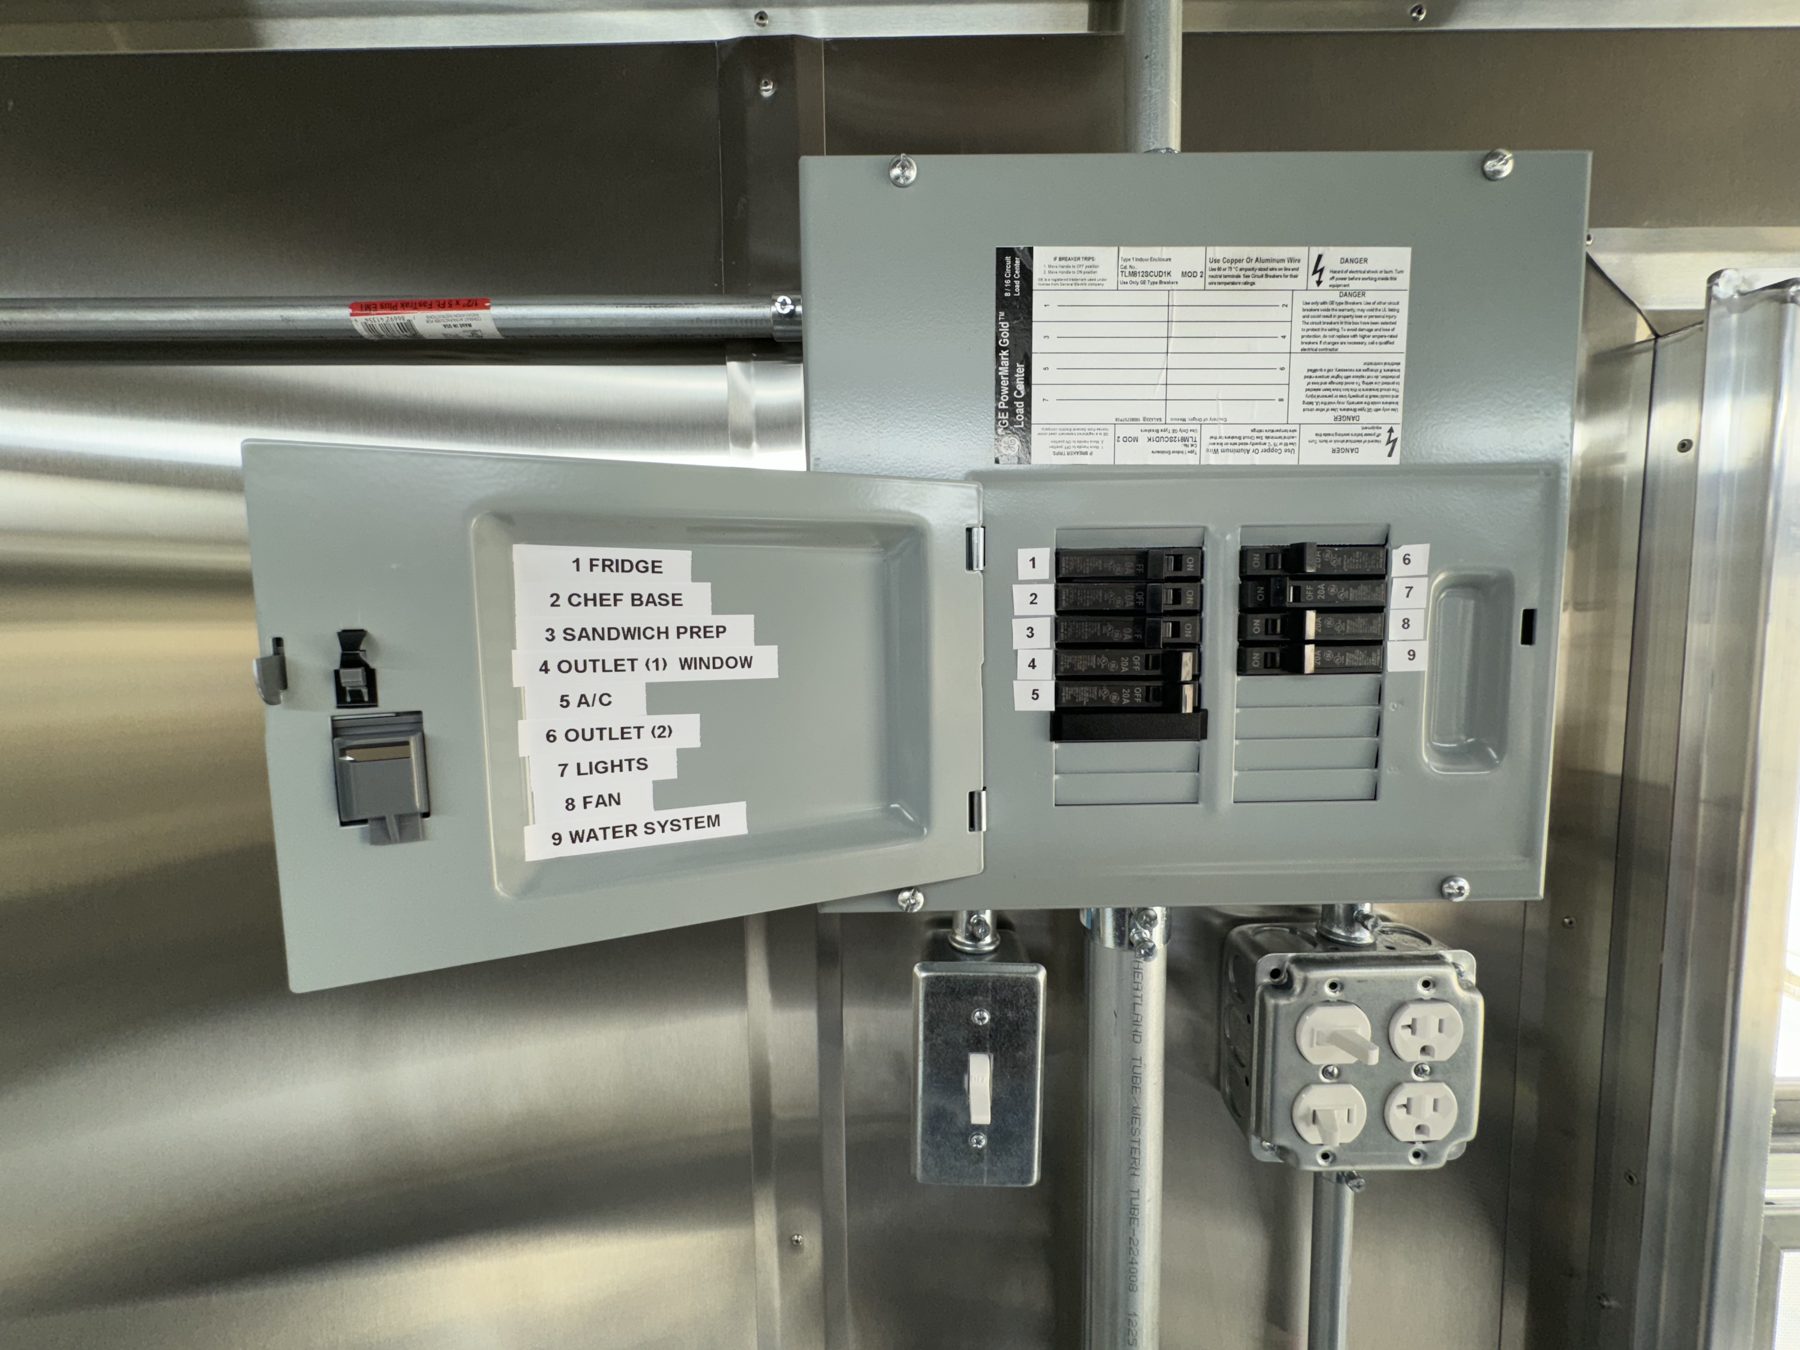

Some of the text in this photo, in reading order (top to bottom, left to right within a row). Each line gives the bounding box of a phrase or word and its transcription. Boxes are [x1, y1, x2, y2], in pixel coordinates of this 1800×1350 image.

[998, 350, 1009, 408] PowerMark
[1014, 363, 1025, 428] Load Center
[998, 412, 1009, 428] GE
[572, 558, 663, 574] 1 FRIDGE
[1029, 557, 1036, 568] 1
[1187, 557, 1194, 571] ON
[1252, 553, 1259, 568] ON
[1402, 554, 1411, 565] 6
[1029, 592, 1038, 604] 2
[1186, 590, 1194, 604] ON
[1257, 586, 1264, 601] ON
[1305, 585, 1314, 600] OFF
[1317, 584, 1325, 599] 20A
[1405, 586, 1413, 598] 7
[550, 593, 683, 607] 2 CHEF BASE
[1185, 623, 1192, 637] ON
[1252, 619, 1260, 634] ON
[1402, 618, 1410, 629] 8
[545, 625, 727, 642] 3 SANDWICH PREP
[1026, 627, 1034, 638] 3
[1252, 653, 1259, 667] ON
[1407, 650, 1416, 661] 9
[539, 656, 753, 674] 4 OUTLET (1) WINDOW
[1028, 658, 1037, 669] 4
[1120, 656, 1129, 672] 20A
[559, 692, 612, 708] 5 A/C
[1032, 689, 1039, 700] 5
[546, 725, 672, 744] 6 OUTLET (2)
[558, 757, 648, 778] 7 LIGHTS
[565, 792, 621, 811] 8 FAN
[552, 814, 720, 846] 9 WATER SYSTEM
